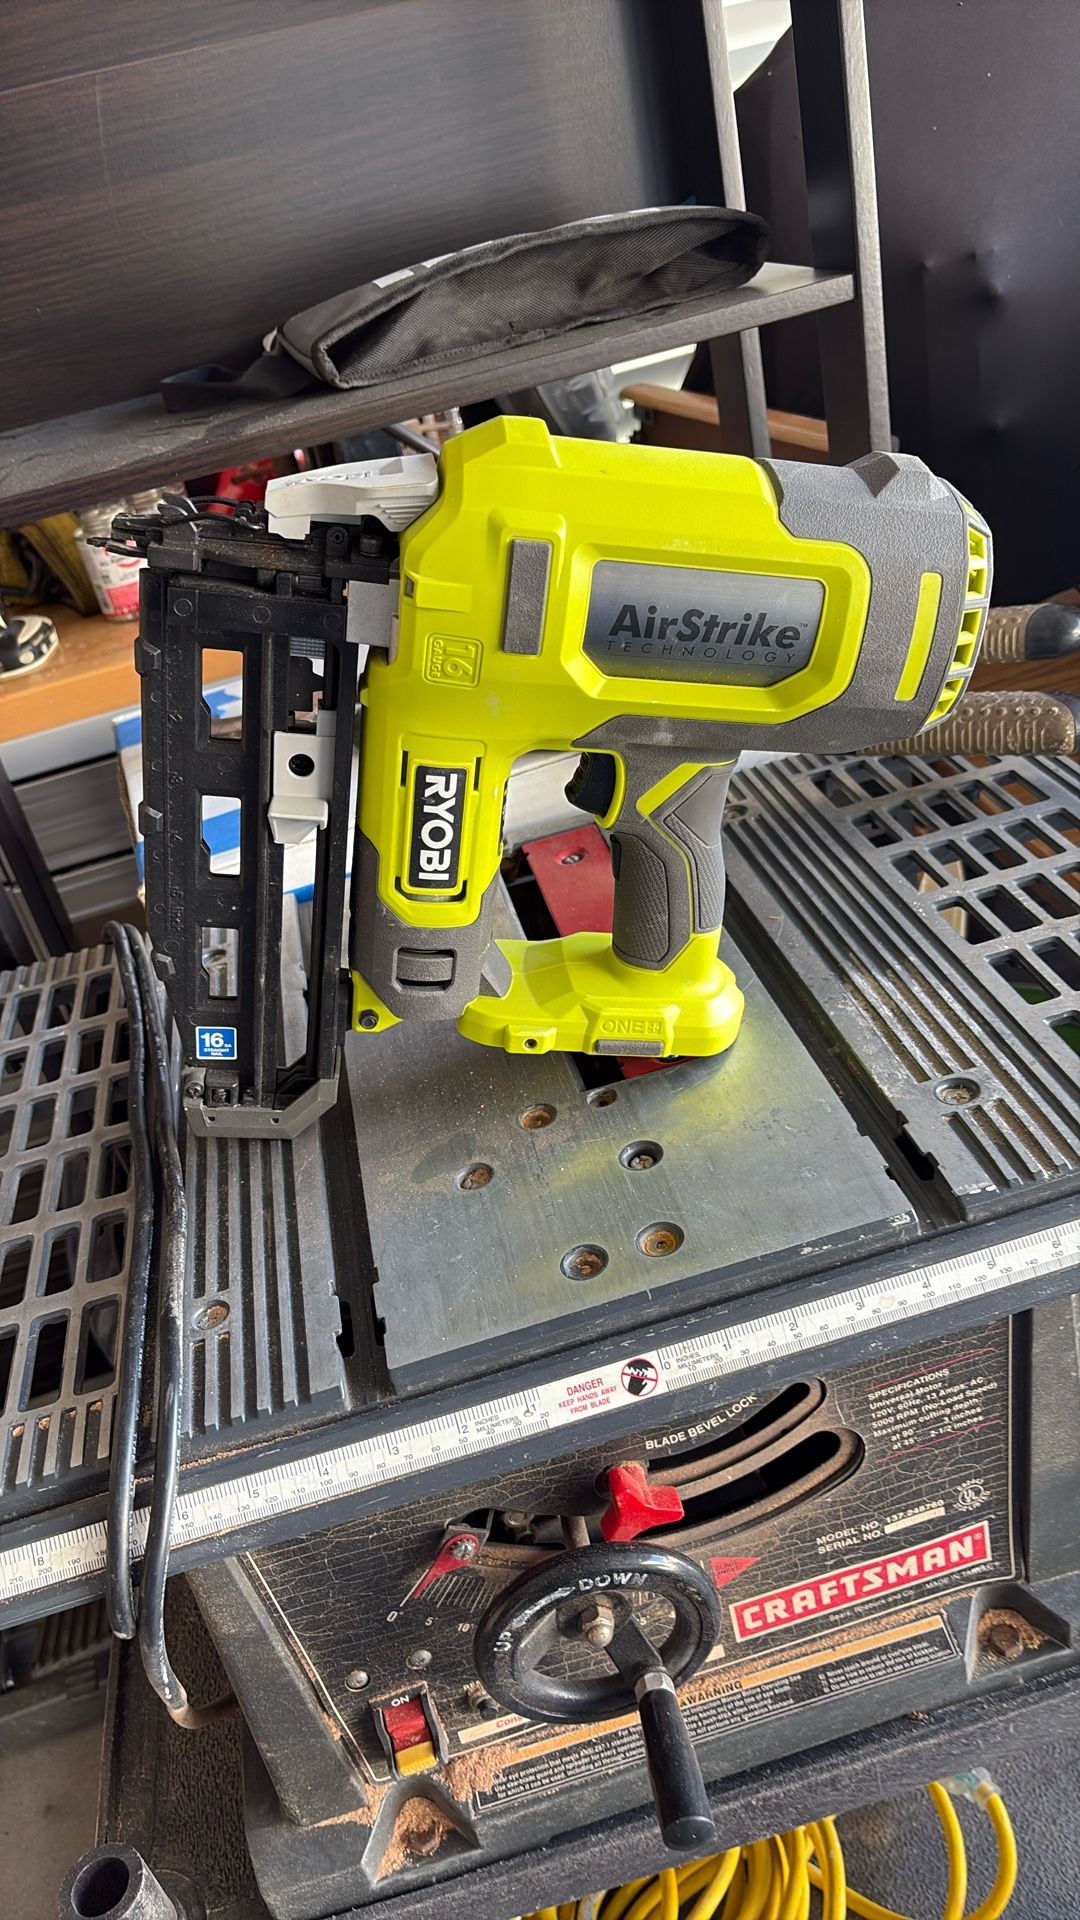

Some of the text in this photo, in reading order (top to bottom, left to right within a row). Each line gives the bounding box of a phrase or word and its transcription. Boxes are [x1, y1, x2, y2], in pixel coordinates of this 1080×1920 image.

[608, 604, 800, 648] AirStrike
[430, 639, 444, 679] GAUGE
[444, 644, 475, 678] 16
[606, 640, 797, 663] TECHNOLOGY
[418, 774, 458, 880] RYOBI
[200, 1032, 224, 1048] 16
[664, 1362, 671, 1370] 0
[789, 1322, 796, 1332] 2
[856, 1302, 863, 1311] 3
[922, 1281, 929, 1289] 4
[987, 1261, 994, 1270] 5
[688, 1364, 696, 1372] 10
[948, 1282, 962, 1290] 110
[974, 1274, 988, 1282] 120
[1000, 1266, 1012, 1274] 130
[676, 1352, 700, 1363] INCHES
[678, 1353, 718, 1369] MILLIMETERS
[566, 1378, 604, 1396] DANGER
[868, 1369, 950, 1400] SPECIFICATIONS
[558, 1386, 617, 1408] KEEP HANDS AWAY
[570, 1398, 611, 1414] FROM BLADE
[870, 1391, 914, 1410] Universal
[475, 1415, 499, 1426] INCHES
[476, 1416, 518, 1433] MILLIMETERS
[646, 1392, 758, 1450] BLADE BEVEL LOCK
[872, 1417, 894, 1428] 5000
[896, 1408, 918, 1421] RPM
[873, 1419, 916, 1438] Maximum
[919, 1408, 950, 1423] cutting
[890, 1434, 900, 1442] at
[952, 1407, 982, 1421] inches
[954, 1416, 984, 1429] inches
[38, 1557, 44, 1566] 8
[182, 1512, 188, 1520] 6
[252, 1488, 260, 1498] 5
[323, 1468, 330, 1476] 4
[392, 1446, 400, 1455] 3
[462, 1425, 469, 1434] 2
[10, 1576, 24, 1584] 210
[38, 1567, 52, 1576] 200
[67, 1558, 81, 1566] 190
[181, 1522, 194, 1530] 150
[210, 1513, 222, 1521] 140
[237, 1504, 250, 1513] 130
[265, 1496, 278, 1504] 120
[292, 1488, 305, 1496] 110
[320, 1479, 334, 1488] 100
[376, 1462, 386, 1470] 80
[816, 1526, 858, 1545] MODEL
[818, 1538, 860, 1554] SERIAL
[578, 1572, 648, 1591] DOWN
[742, 1537, 974, 1630] CRAFTSMAN
[494, 1631, 514, 1652] UP
[391, 1695, 410, 1706] ON
[686, 1679, 742, 1704] WARNING
